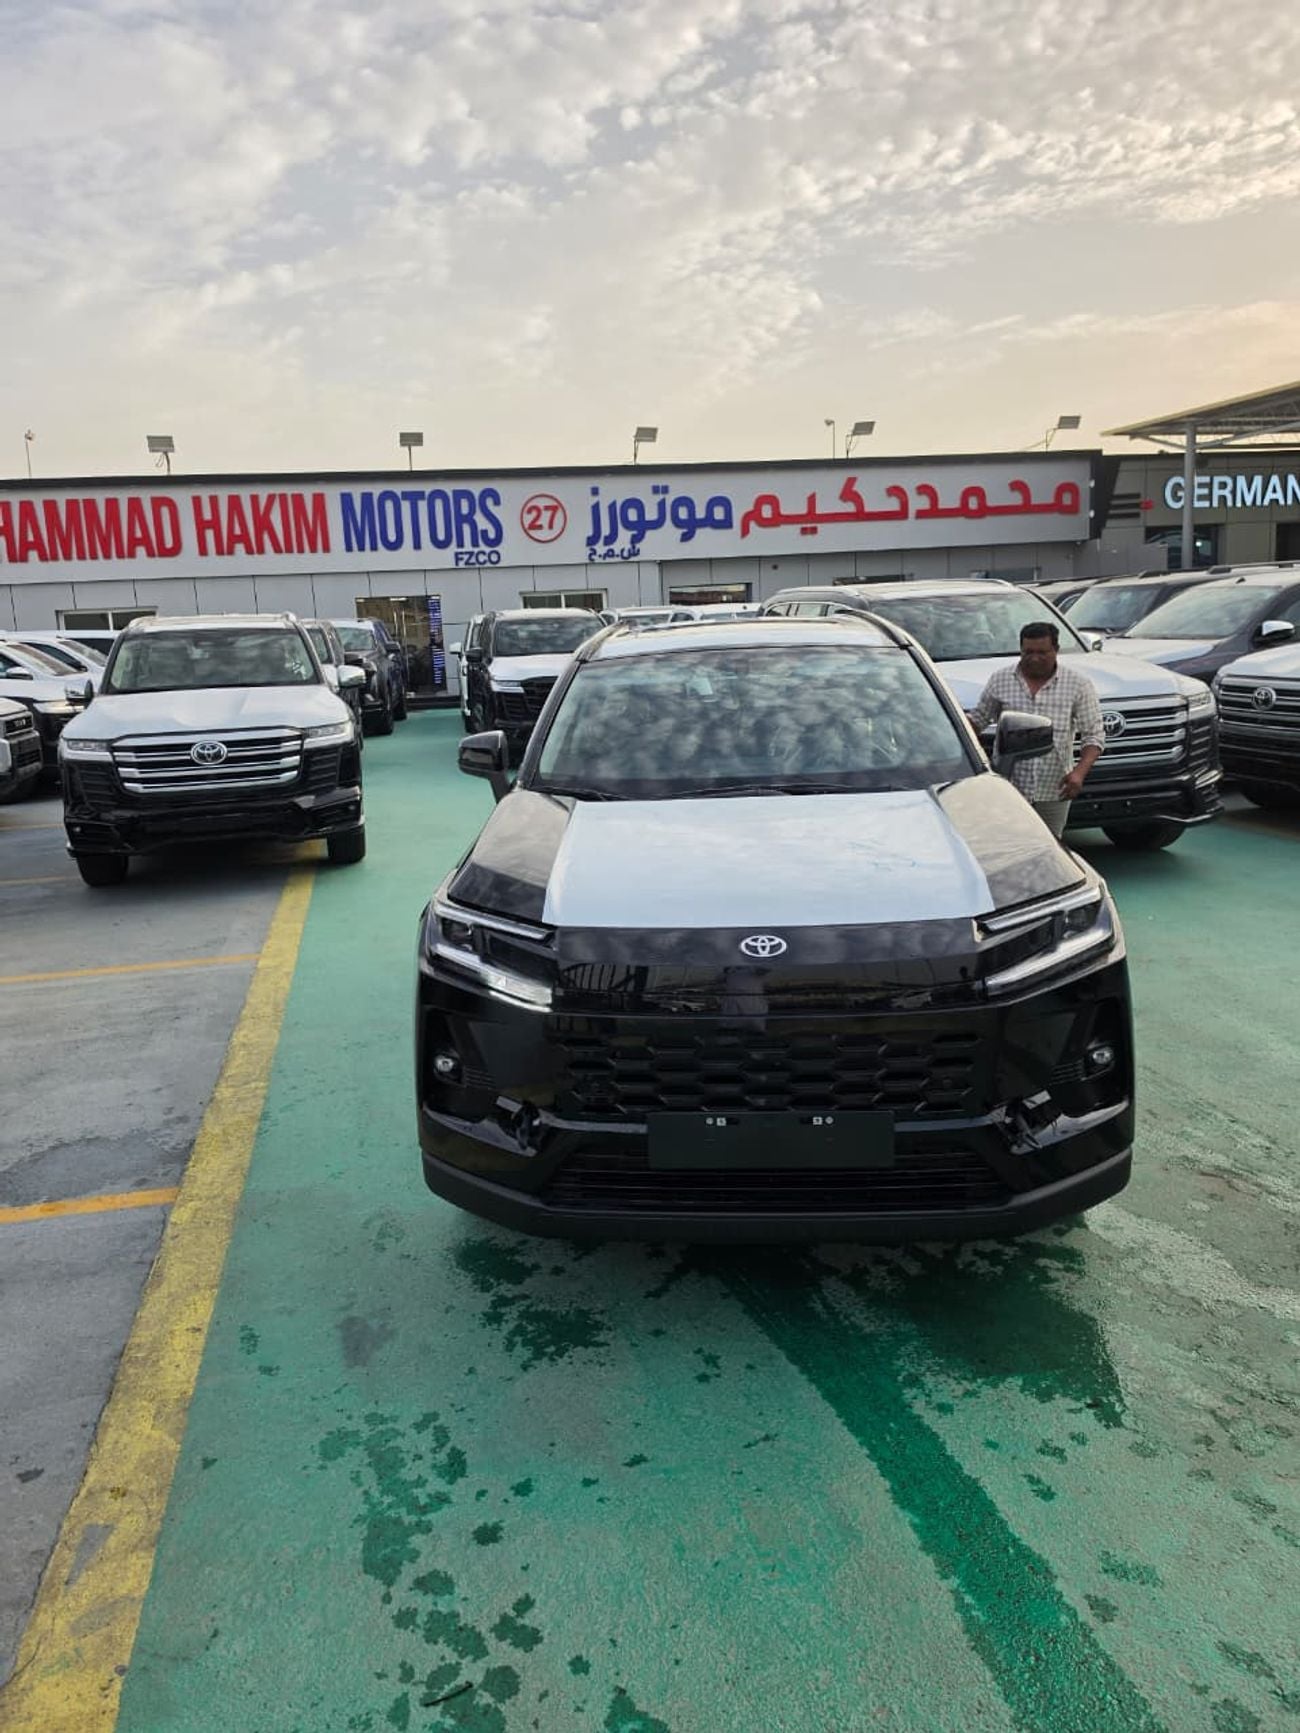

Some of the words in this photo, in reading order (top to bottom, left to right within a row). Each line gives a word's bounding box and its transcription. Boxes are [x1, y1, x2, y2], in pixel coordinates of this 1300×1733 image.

[191, 492, 331, 557] HAKIM
[340, 487, 503, 553] MOTORS
[525, 504, 559, 531] 27
[585, 484, 735, 547] موتورز
[741, 476, 909, 539] حكيم
[915, 479, 1080, 519] محمد
[454, 550, 501, 566] FZCO
